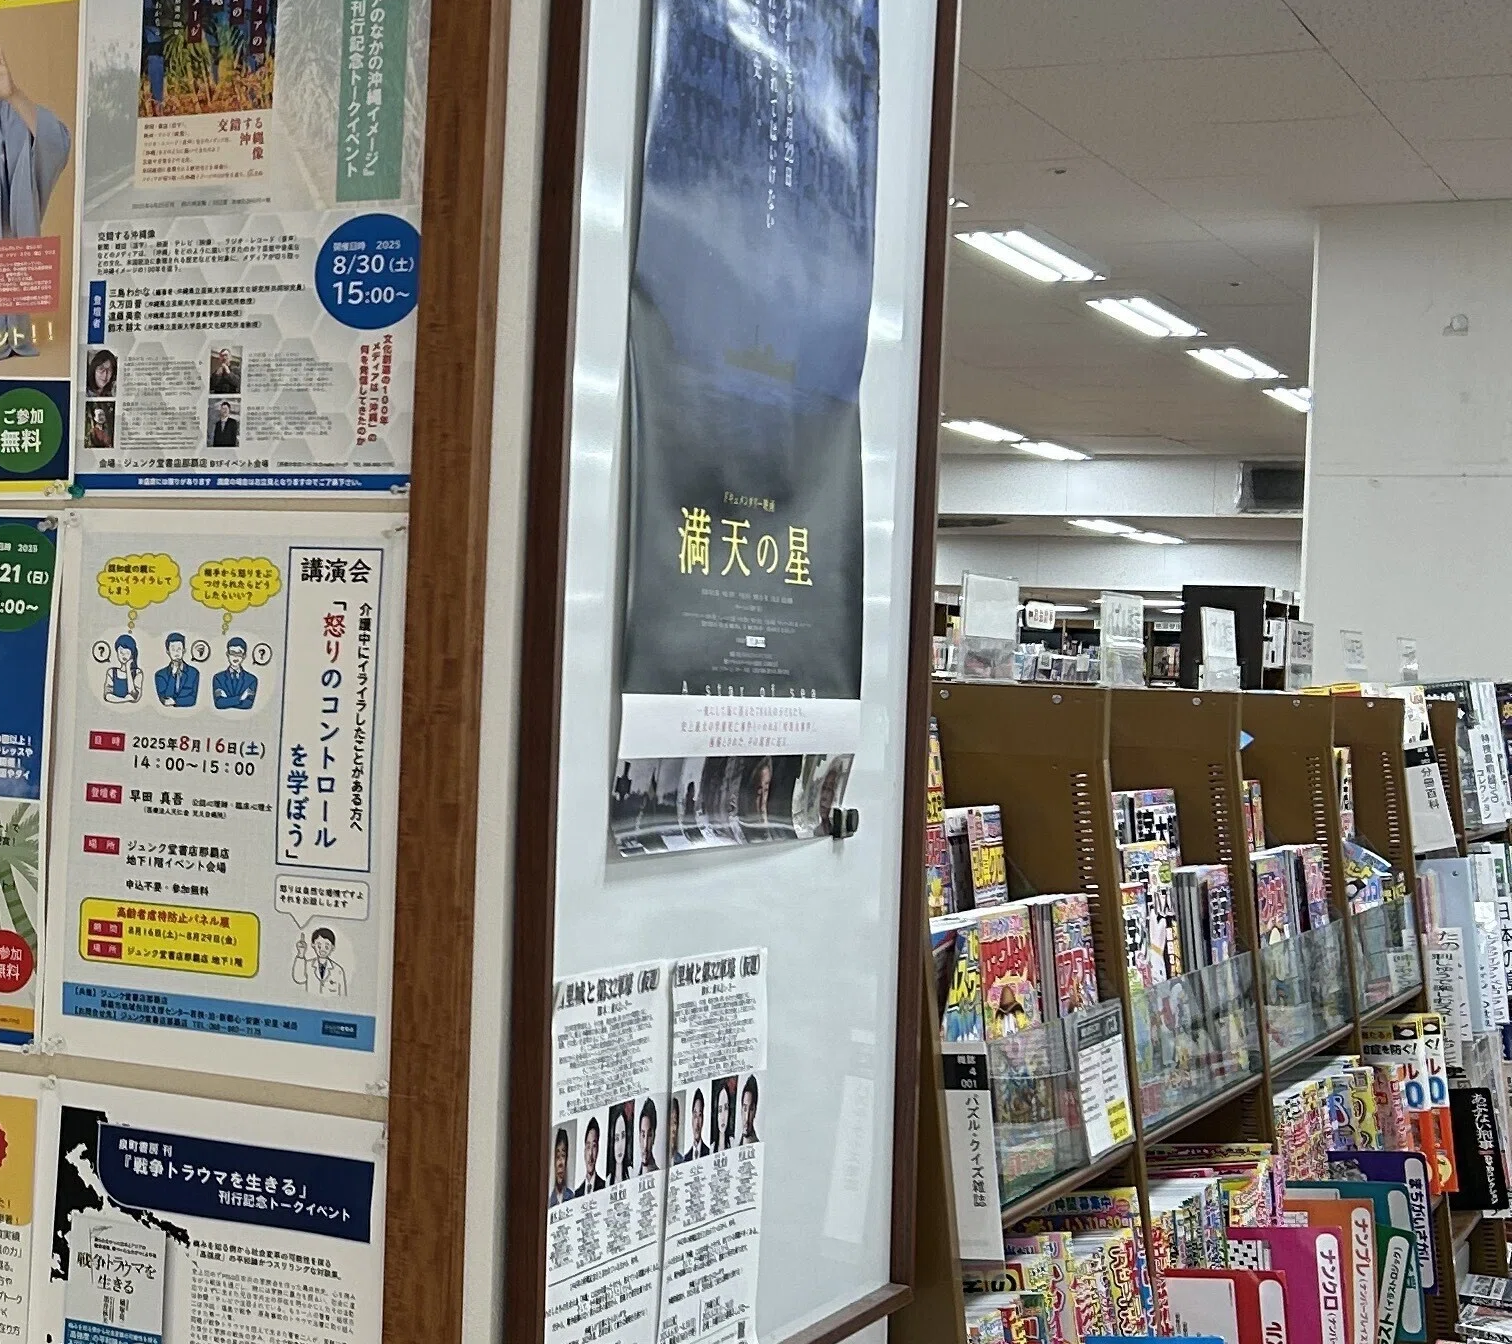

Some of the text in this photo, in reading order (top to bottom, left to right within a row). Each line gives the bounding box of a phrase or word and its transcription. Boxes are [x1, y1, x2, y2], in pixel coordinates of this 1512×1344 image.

[345, 0, 366, 177] 刊行記念トークイベント
[332, 255, 415, 276] 8/30 （土）
[4, 408, 44, 425] ご参加
[0, 430, 41, 453] 無料
[678, 506, 814, 587] 満天の星
[300, 558, 372, 583] 講演会
[314, 600, 347, 849] 「怒りのコントロール
[349, 602, 372, 832] 介護中にイライラしたことがある方へ
[284, 744, 310, 860] を学ぼう」
[128, 841, 229, 859] ジュンク堂書店那覇店
[126, 880, 209, 896] 申込不要・参加無料
[965, 1093, 987, 1208] パズル・クイズ雑誌
[219, 1191, 351, 1221] 刊行記念トークイベント
[1409, 1178, 1430, 1267] まちがいさがし
[77, 1251, 157, 1280] 戦争トラウマを
[98, 1275, 134, 1295] 生きる
